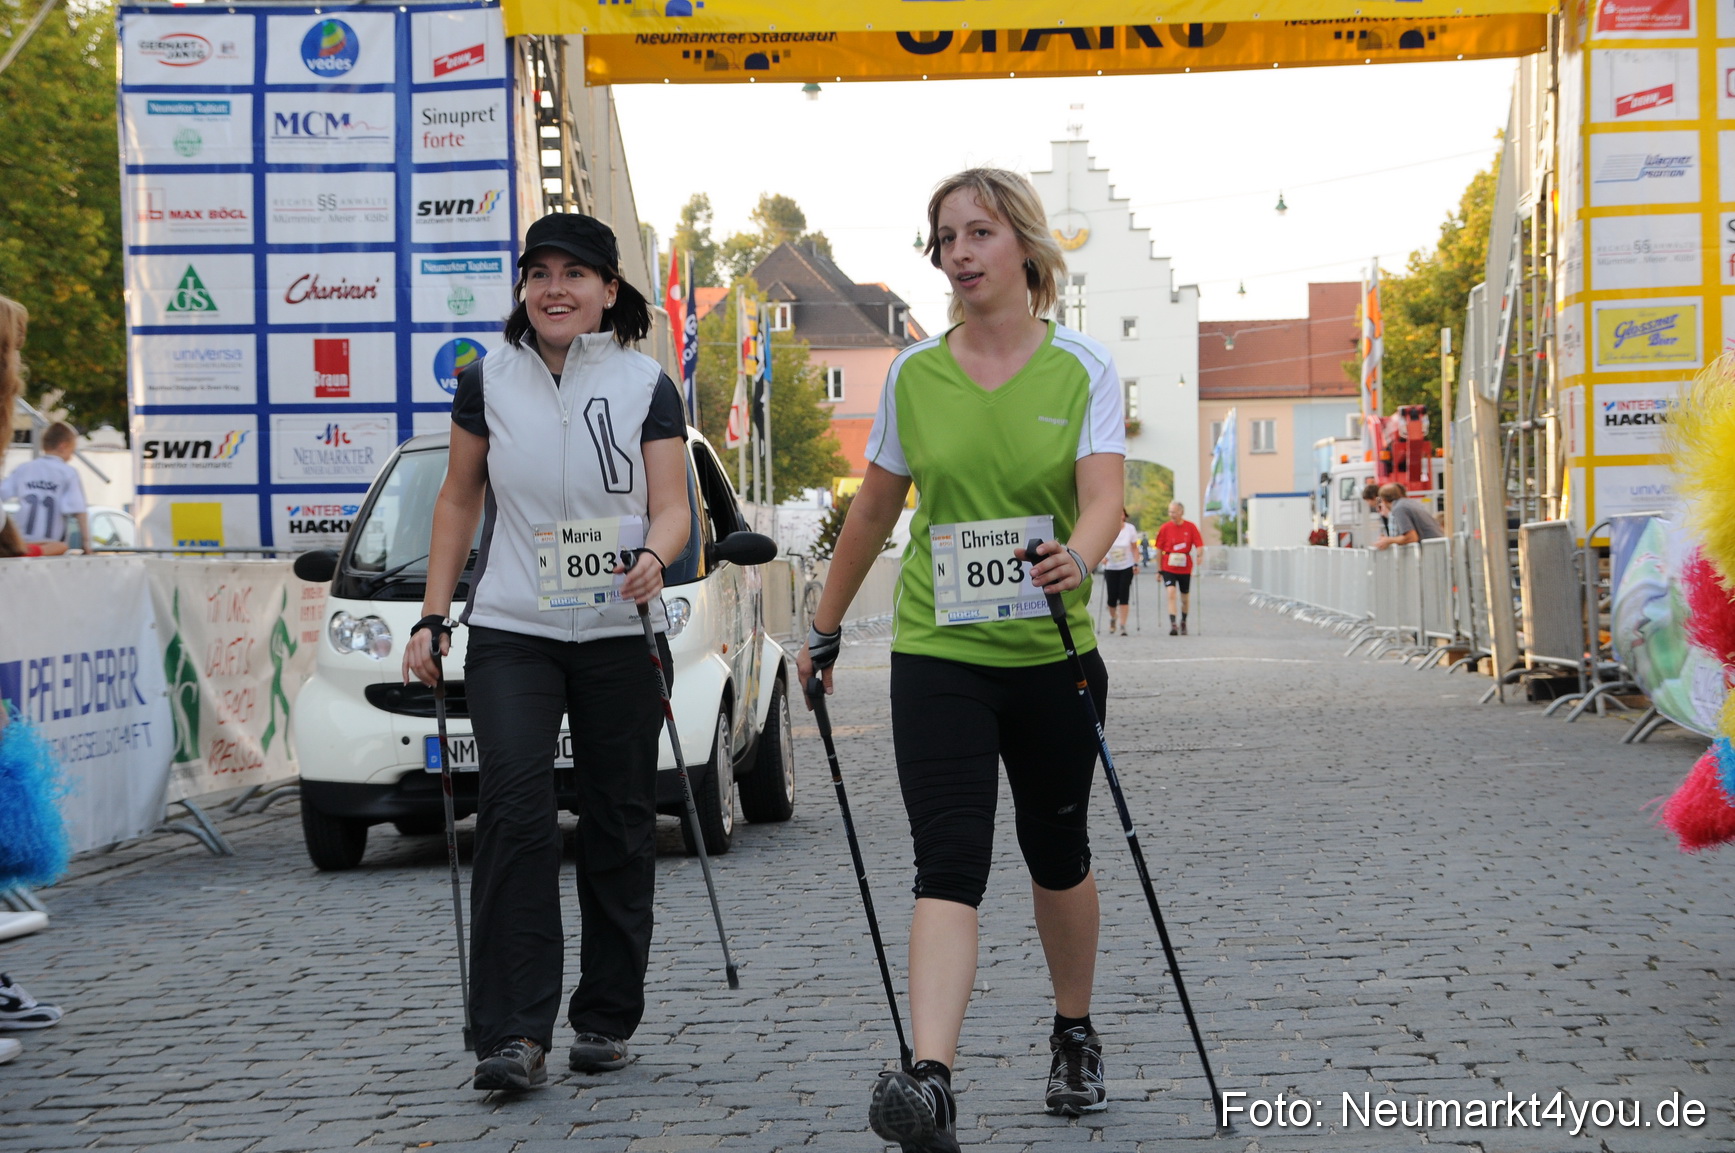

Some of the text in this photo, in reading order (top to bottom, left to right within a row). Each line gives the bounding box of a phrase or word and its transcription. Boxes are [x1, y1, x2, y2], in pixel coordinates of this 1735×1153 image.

[306, 55, 353, 71] vedes
[274, 111, 351, 137] MCM
[422, 107, 496, 128] Sinupret
[423, 131, 465, 149] forte
[169, 210, 203, 219] MAX
[416, 198, 475, 217] swn
[424, 261, 499, 272] Neumarkter Tagblatt
[173, 348, 243, 361] universa
[143, 440, 212, 459] swn
[293, 447, 374, 467] NEUMARKTER
[562, 528, 602, 544] Maria
[961, 530, 1020, 549] Christa
[539, 551, 618, 578] N 803
[937, 557, 1025, 587] N 803
[1011, 600, 1050, 612] PFLEIDER
[28, 646, 147, 723] PFLEIDERER
